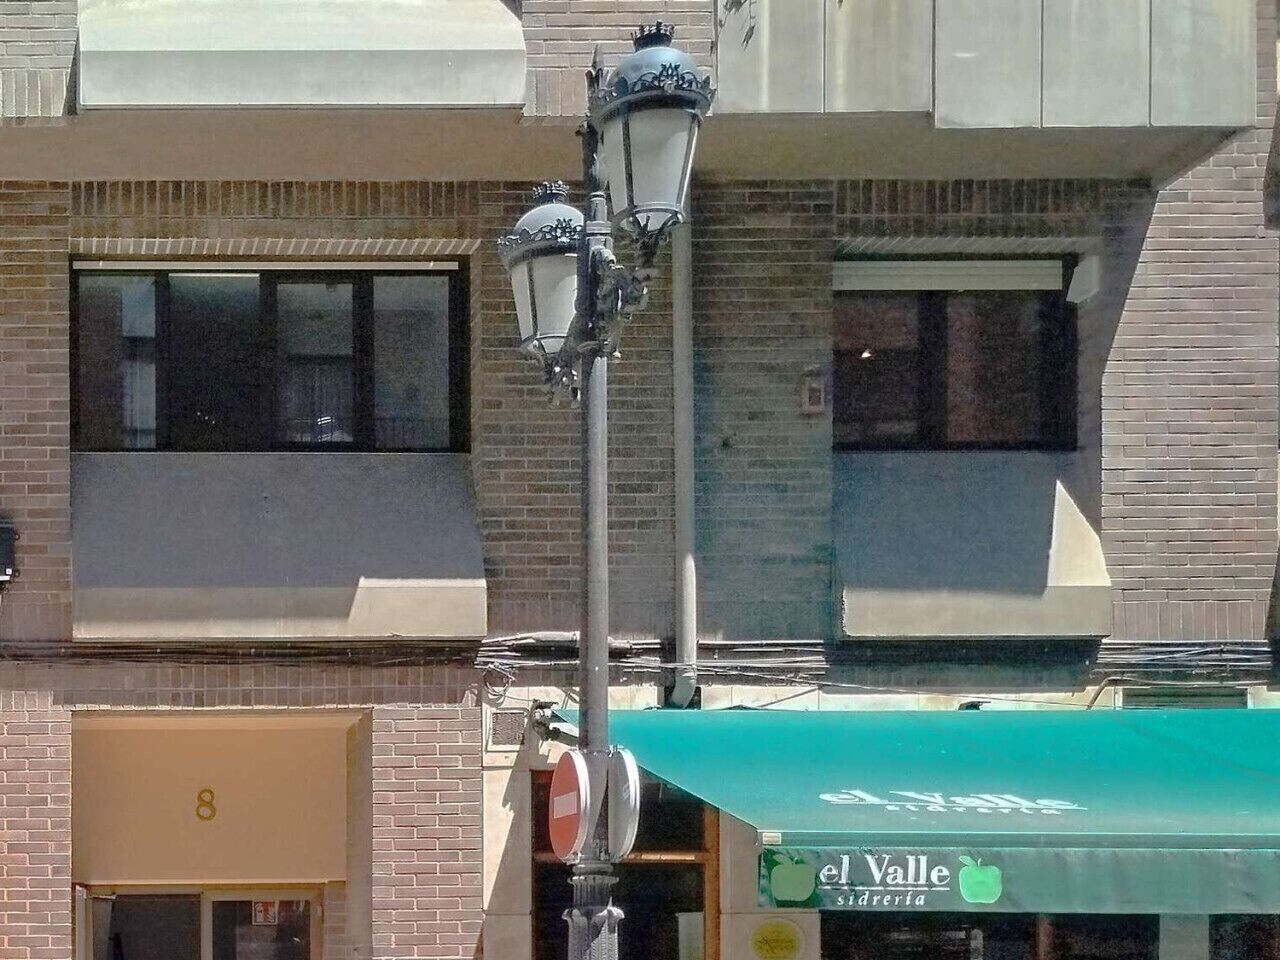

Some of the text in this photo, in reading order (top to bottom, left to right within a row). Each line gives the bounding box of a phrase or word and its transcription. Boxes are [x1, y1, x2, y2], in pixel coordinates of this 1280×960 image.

[196, 789, 216, 821] 8
[819, 789, 888, 804] el
[819, 855, 950, 885] el Valle
[837, 890, 925, 906] sidrería
